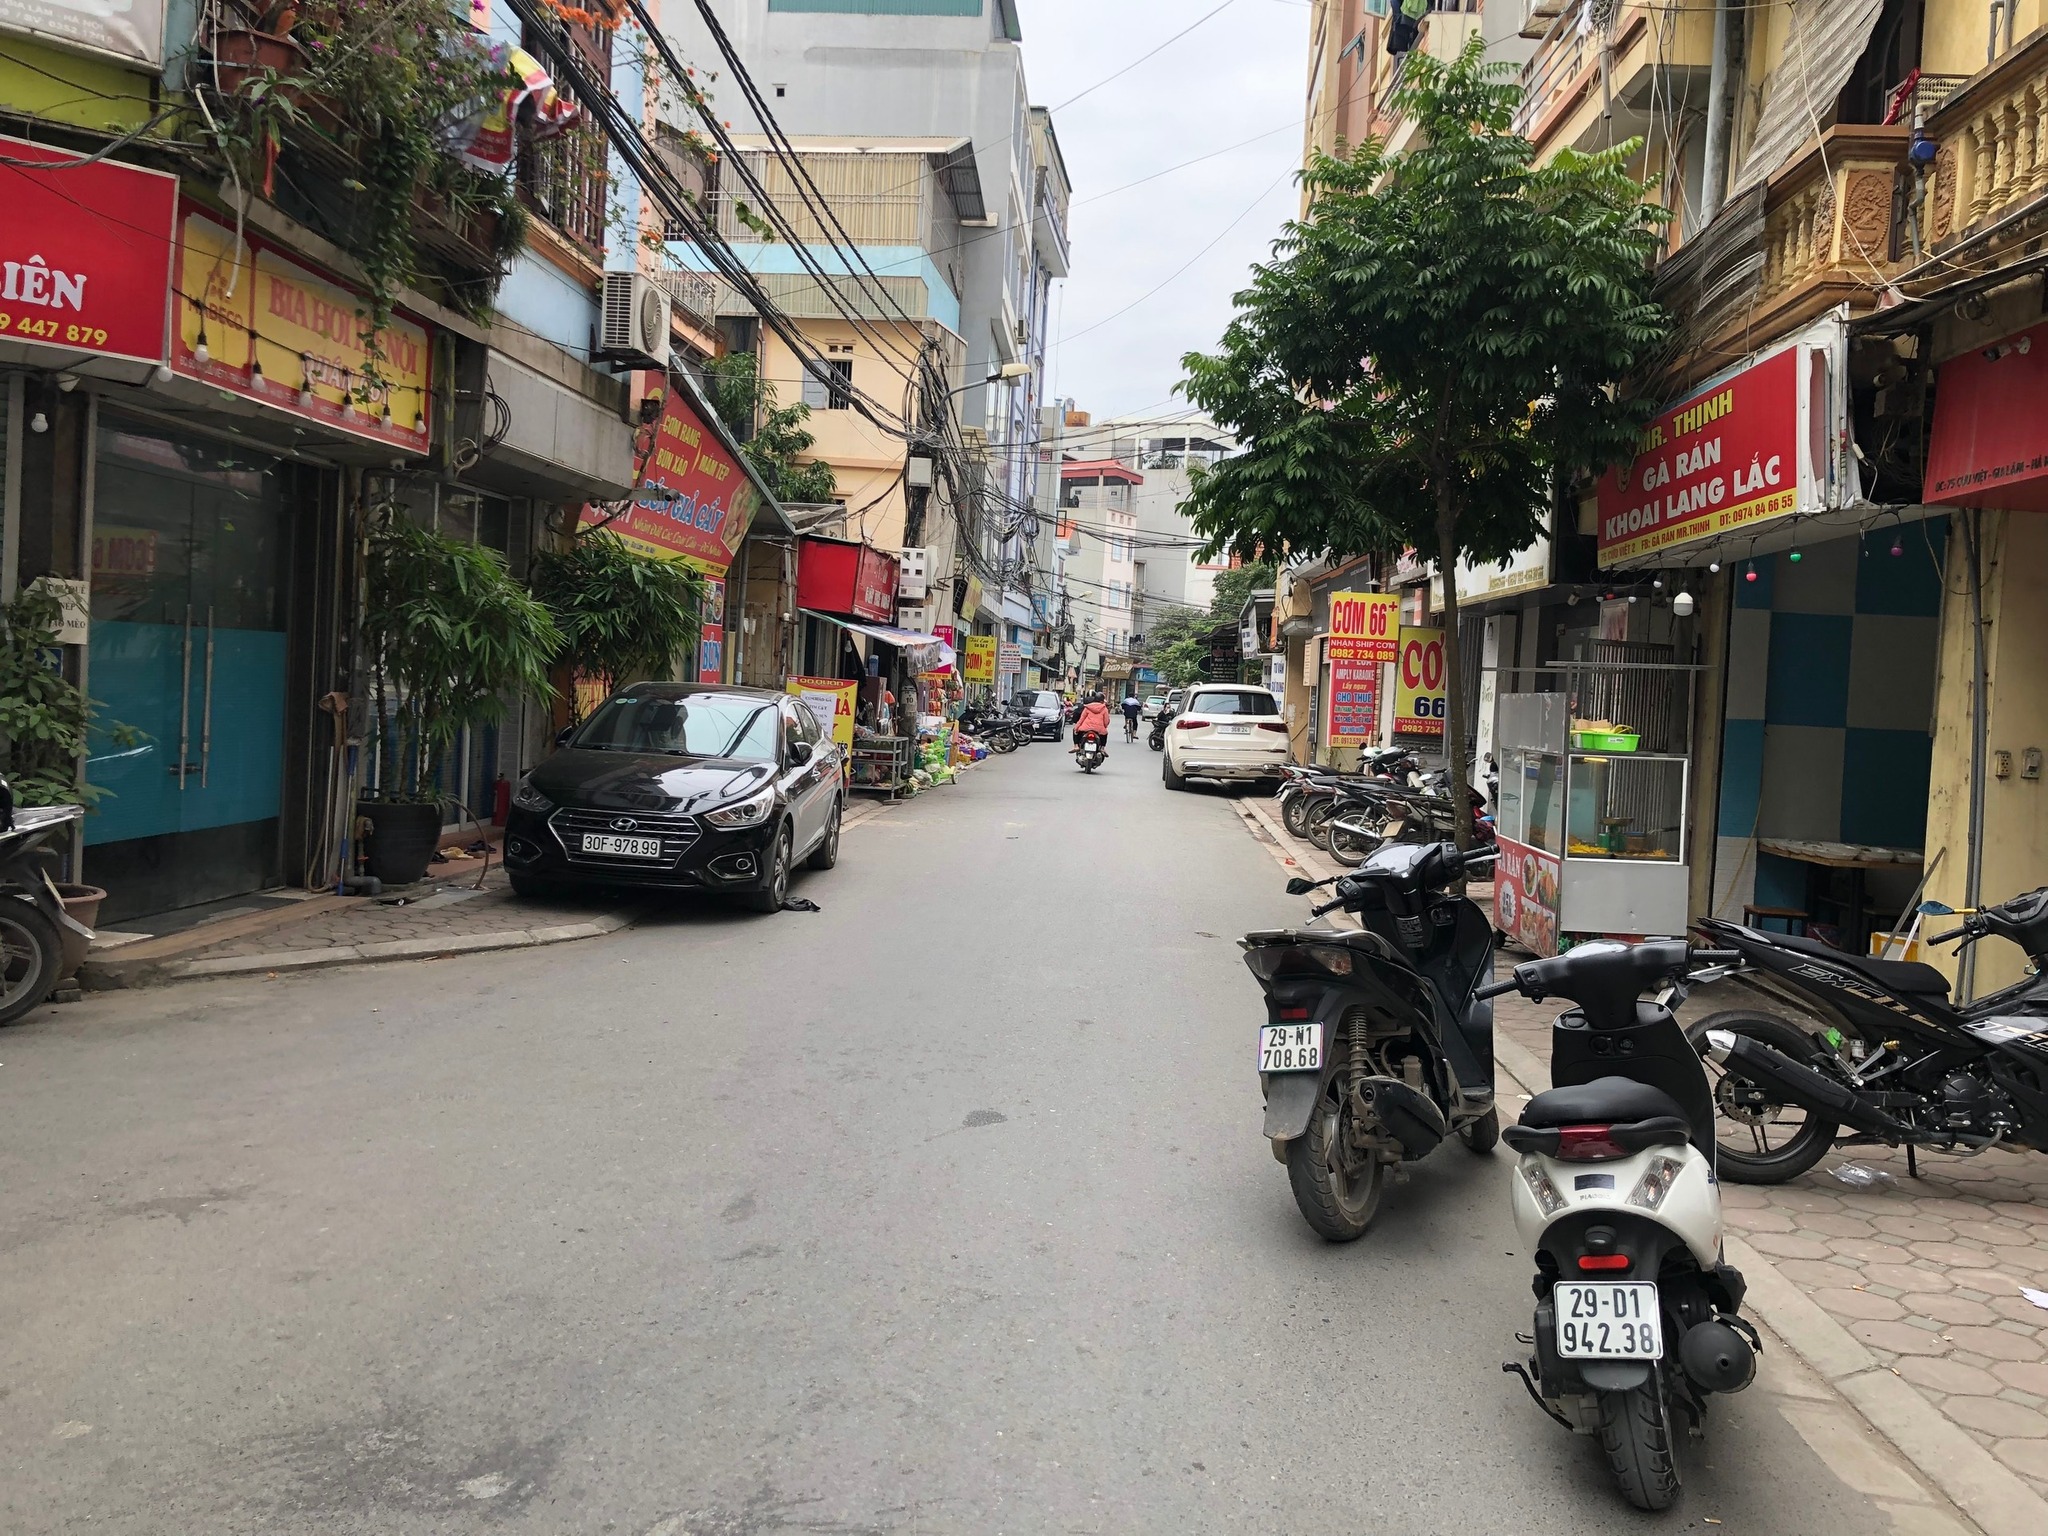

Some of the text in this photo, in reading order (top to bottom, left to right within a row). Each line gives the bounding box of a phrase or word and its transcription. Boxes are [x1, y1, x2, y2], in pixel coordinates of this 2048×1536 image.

[269, 275, 308, 330] BIA
[17, 317, 58, 338] 447
[66, 324, 108, 345] 879
[1673, 388, 1733, 433] THỊNH
[679, 423, 702, 449] RANG
[1642, 437, 1721, 491] GÀ RÁN
[1605, 451, 1780, 541] KHOAI LANG LẮC
[1641, 539, 1650, 550] FB:
[1651, 536, 1661, 547] GÀ
[1661, 533, 1675, 545] RÁN
[1733, 506, 1753, 523] 0974
[1755, 503, 1766, 516] 84
[1768, 498, 1779, 513] 66
[1781, 494, 1793, 509] 55
[1333, 598, 1365, 634] CƠM
[700, 632, 722, 672] BÚN
[1331, 648, 1394, 660] 0982 734 089
[1376, 641, 1396, 649] CƠM
[1403, 632, 1446, 691] CƠ
[1336, 692, 1351, 702] CHO
[1414, 696, 1445, 718] 66
[1402, 724, 1441, 734] 0982 734
[584, 835, 658, 856] 30F-978.99
[1263, 1048, 1318, 1069] 708.68
[1570, 1288, 1640, 1318] 29-D1
[1563, 1322, 1654, 1354] 942.38
